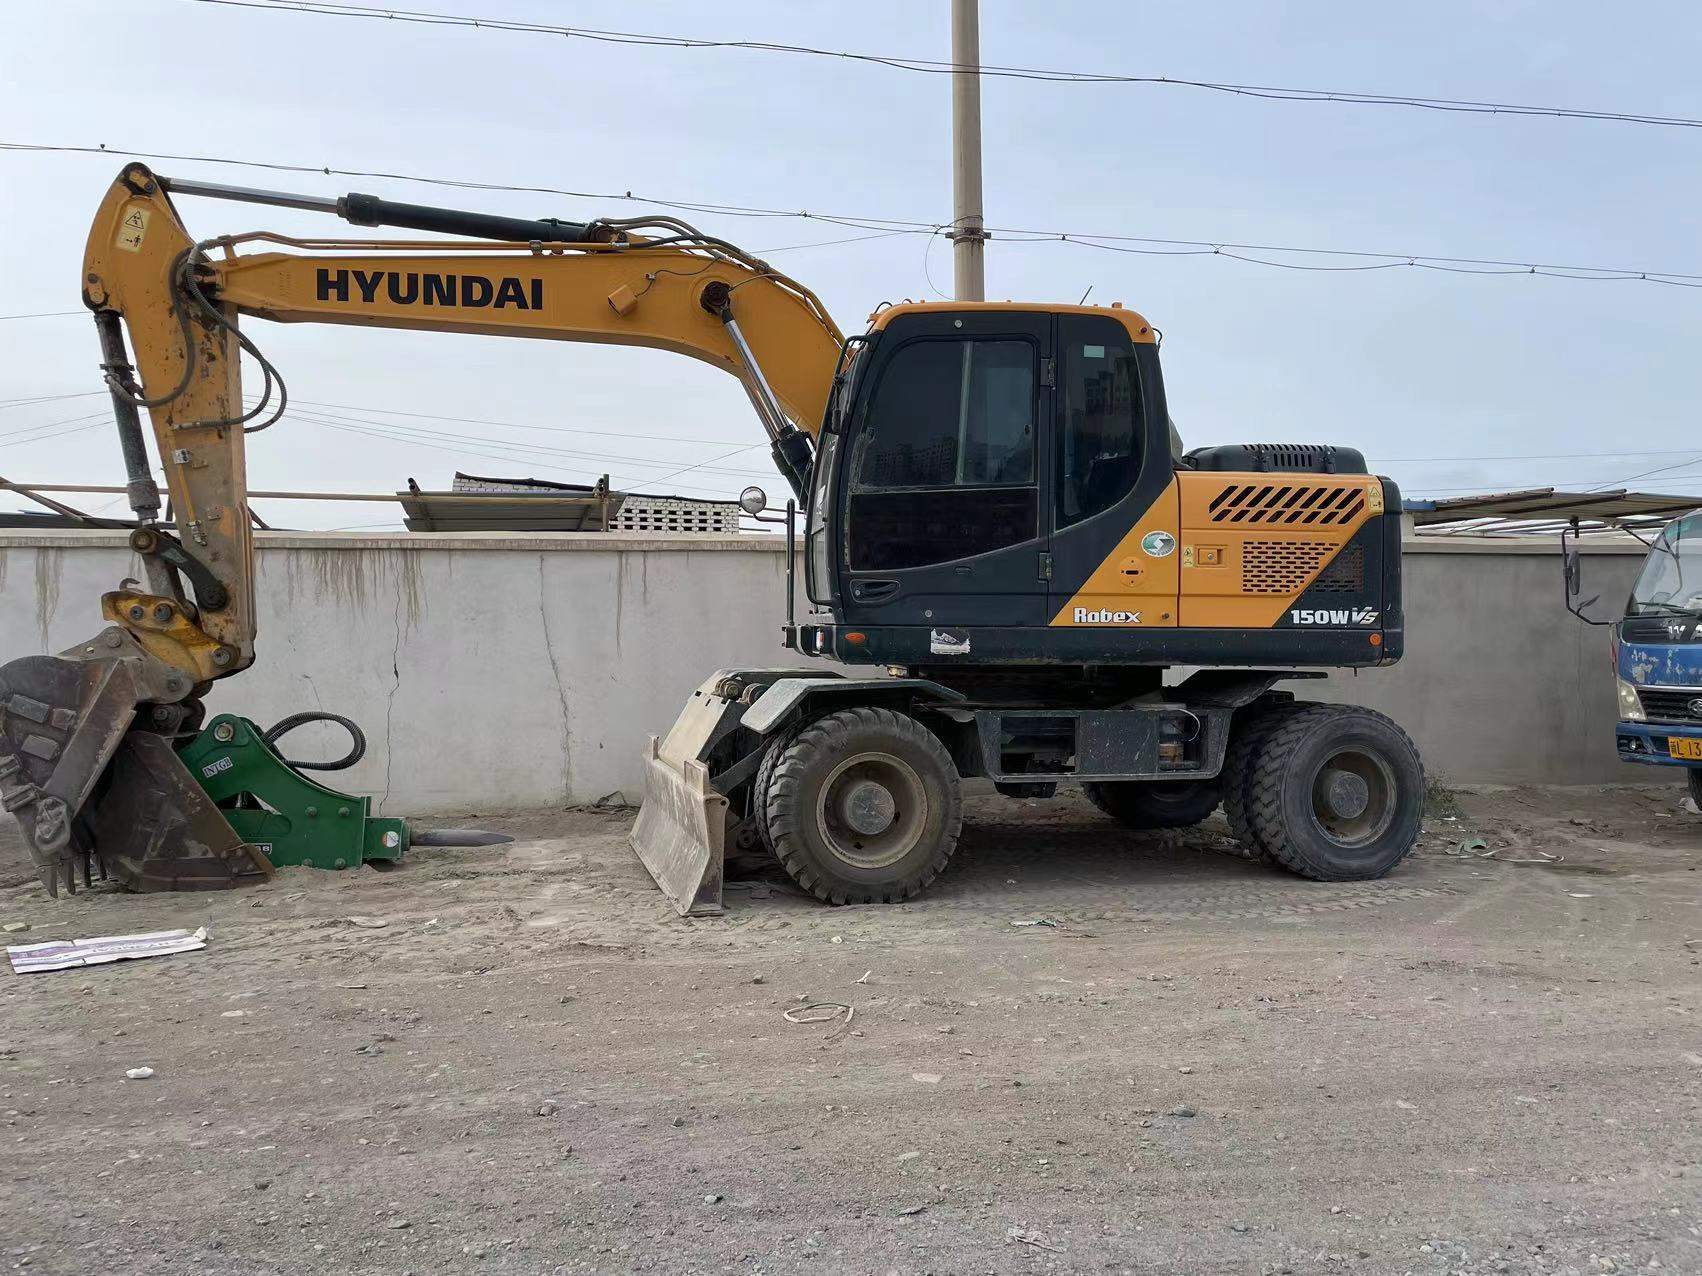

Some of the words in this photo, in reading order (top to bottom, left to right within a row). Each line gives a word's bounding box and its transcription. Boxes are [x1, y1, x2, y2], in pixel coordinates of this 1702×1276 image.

[316, 268, 543, 310] HYUNDAI
[1074, 607, 1141, 623] Robex
[1291, 610, 1349, 624] 150W
